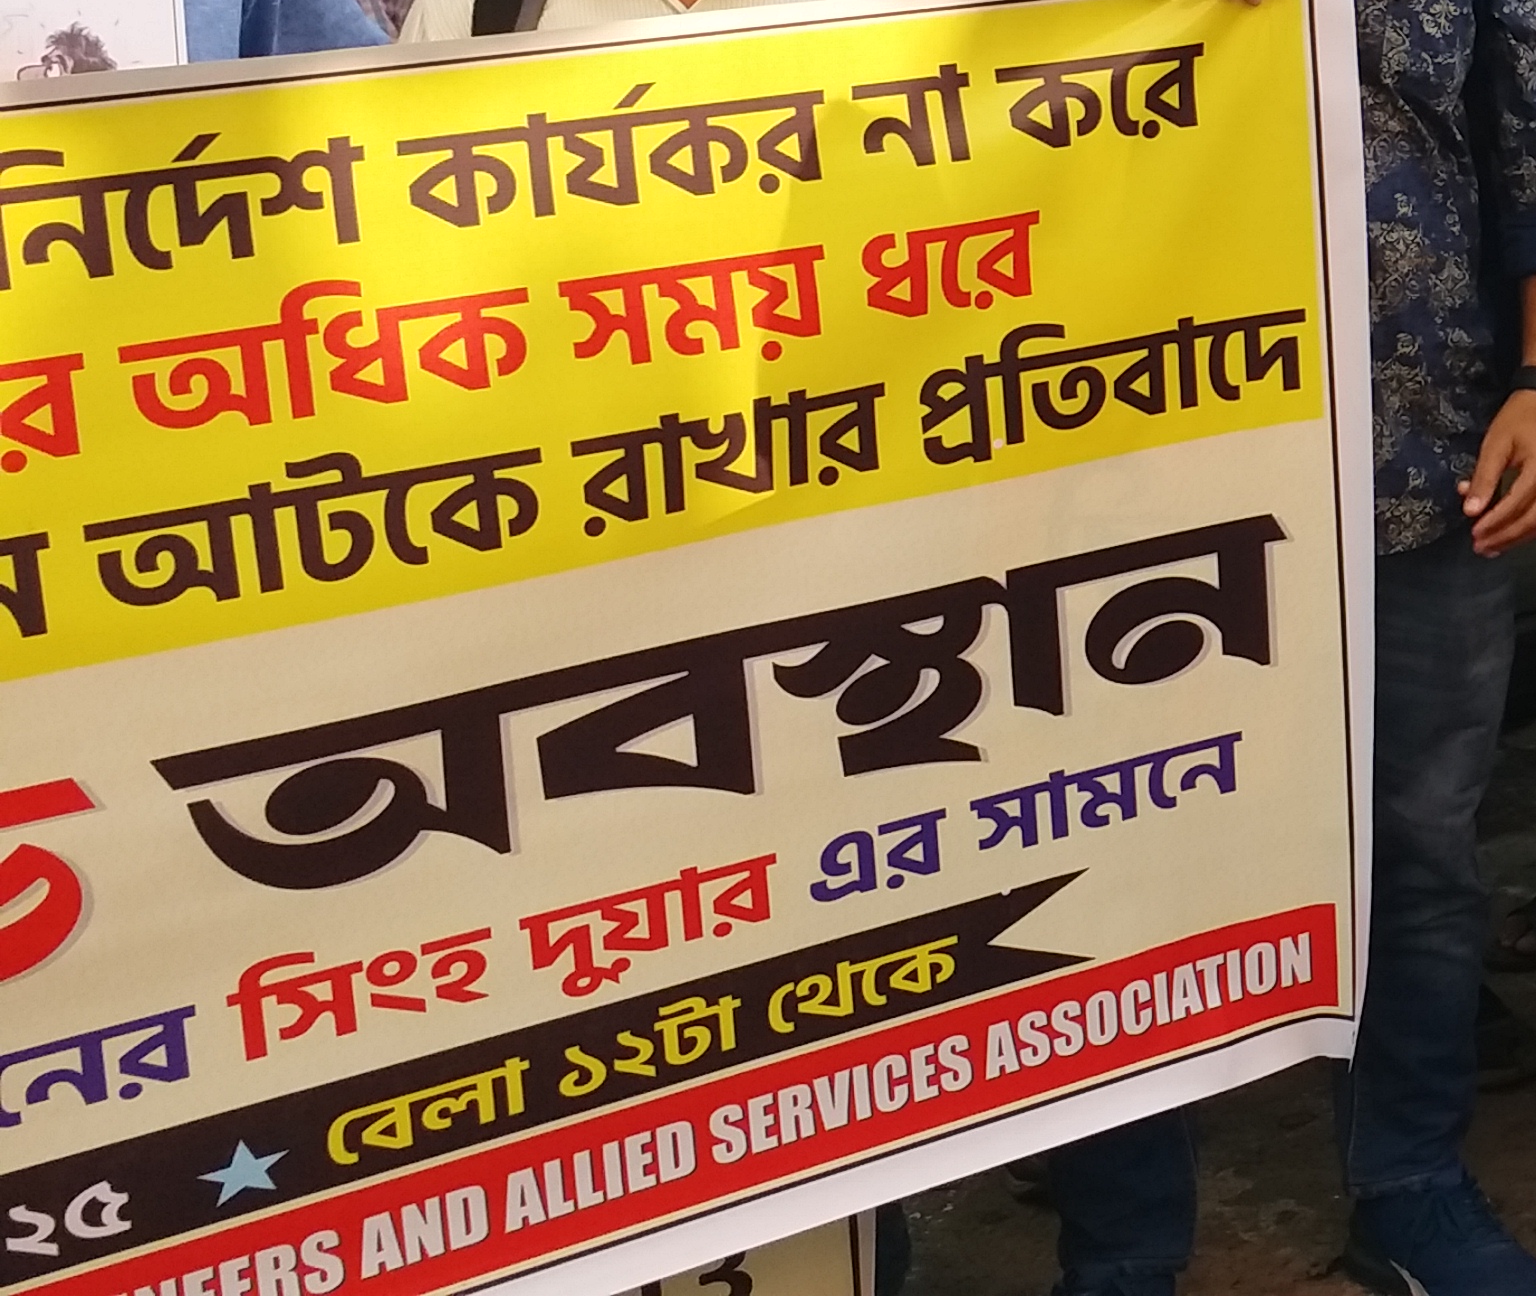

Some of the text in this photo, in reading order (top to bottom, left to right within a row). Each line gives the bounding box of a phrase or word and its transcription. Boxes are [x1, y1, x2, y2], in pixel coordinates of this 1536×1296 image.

[396, 81, 825, 228] কার্যকর
[852, 62, 970, 168] না
[995, 41, 1205, 149] করে
[83, 447, 542, 607] আটকে
[570, 381, 885, 537] রাখার
[919, 307, 1306, 465] প্রতিবাদে
[118, 278, 529, 430] অধিক
[558, 244, 826, 365] সময়
[861, 210, 1041, 318] ধরে
[150, 513, 1290, 891] অবস্থান
[225, 926, 492, 1062] সিংহ
[519, 853, 778, 998] দুয়ার
[809, 808, 947, 904] এর
[970, 731, 1243, 852] সামনে
[326, 1056, 531, 1166] বেলা
[557, 994, 743, 1099] ১২টা
[766, 934, 960, 1034] থেকে
[361, 1184, 490, 1280] AND
[505, 1120, 698, 1233] ALLIED
[711, 1034, 974, 1165] SERVICES
[985, 931, 1313, 1082] ASSOCIATION
